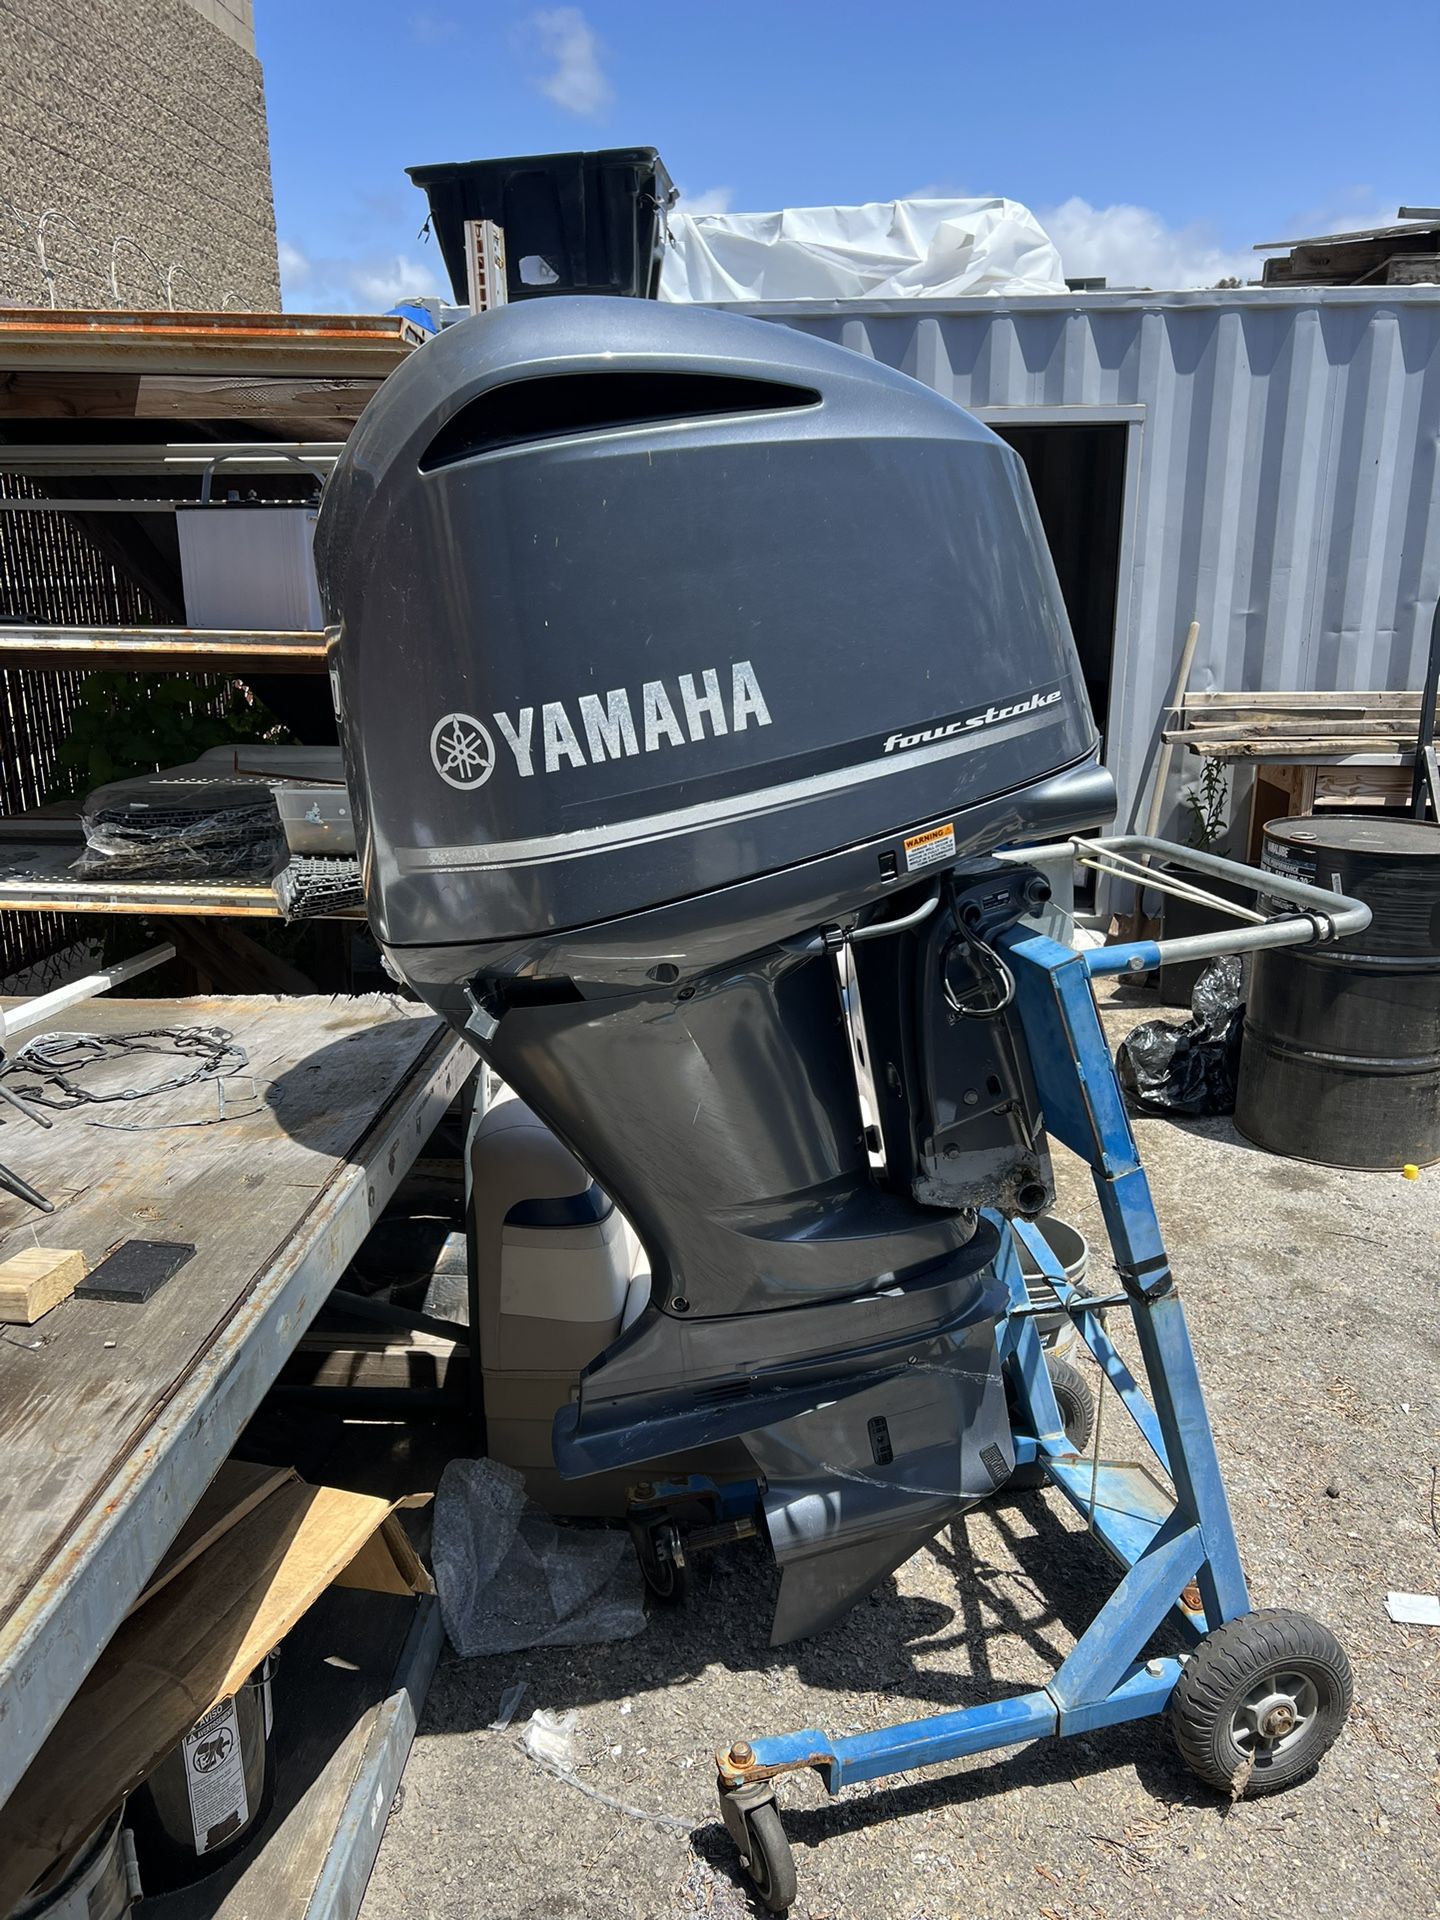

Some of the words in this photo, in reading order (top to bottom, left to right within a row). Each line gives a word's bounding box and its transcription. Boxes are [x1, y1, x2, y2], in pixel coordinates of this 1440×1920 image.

[492, 660, 773, 777] YAMAHA
[906, 829, 944, 848] WARNING
[199, 1704, 223, 1727] AVISO
